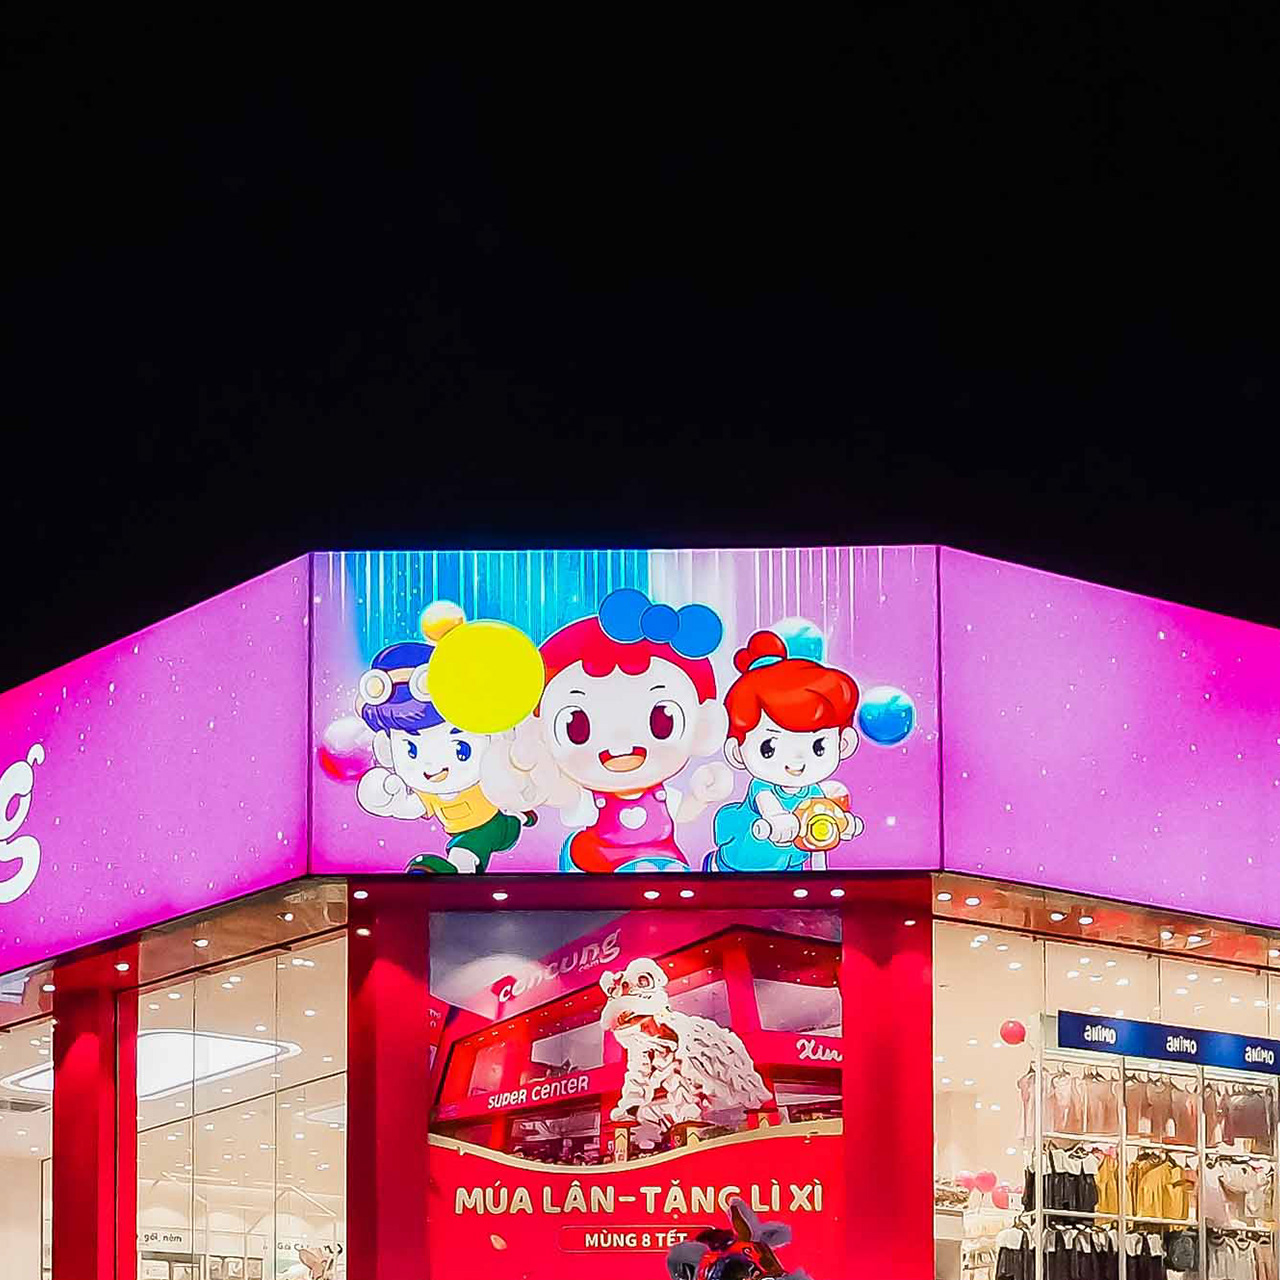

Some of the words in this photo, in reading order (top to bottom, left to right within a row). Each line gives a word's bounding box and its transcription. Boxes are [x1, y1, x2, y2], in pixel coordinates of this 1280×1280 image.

[454, 1180, 534, 1215] MÚA
[751, 1179, 782, 1213] LÌ
[789, 1179, 824, 1213] XÌ
[584, 1227, 638, 1249] MÙNG
[641, 1232, 651, 1248] 8
[655, 1226, 689, 1248] TẾT
